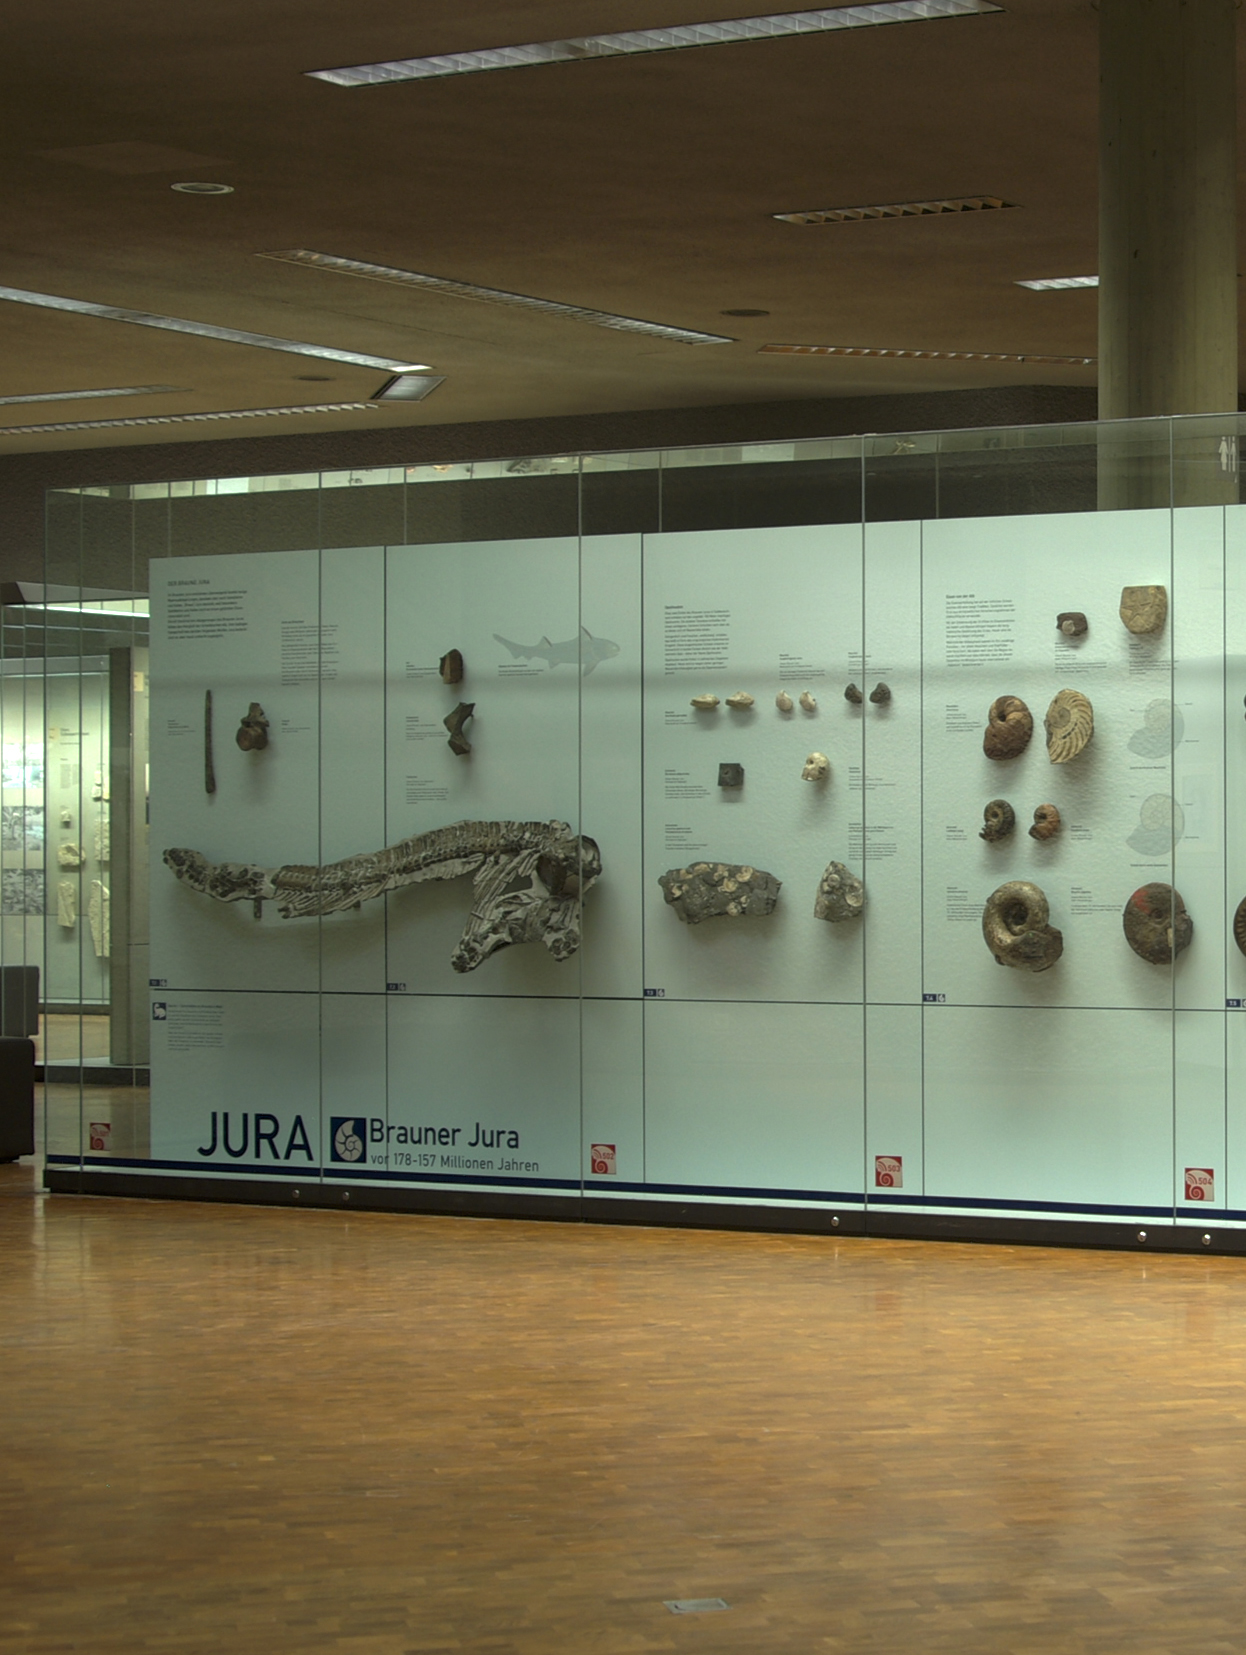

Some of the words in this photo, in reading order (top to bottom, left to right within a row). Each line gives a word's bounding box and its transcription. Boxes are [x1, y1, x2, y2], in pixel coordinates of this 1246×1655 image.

[197, 1111, 315, 1161] JURA
[370, 1118, 462, 1146] Brauner
[468, 1122, 520, 1149] Jura
[371, 1154, 389, 1165] vor
[394, 1153, 436, 1167] 178-157
[440, 1155, 493, 1170] Millionen
[497, 1158, 539, 1172] Jahren
[602, 1152, 614, 1160] 502
[887, 1165, 901, 1173] 503
[1198, 1177, 1213, 1185] 504
